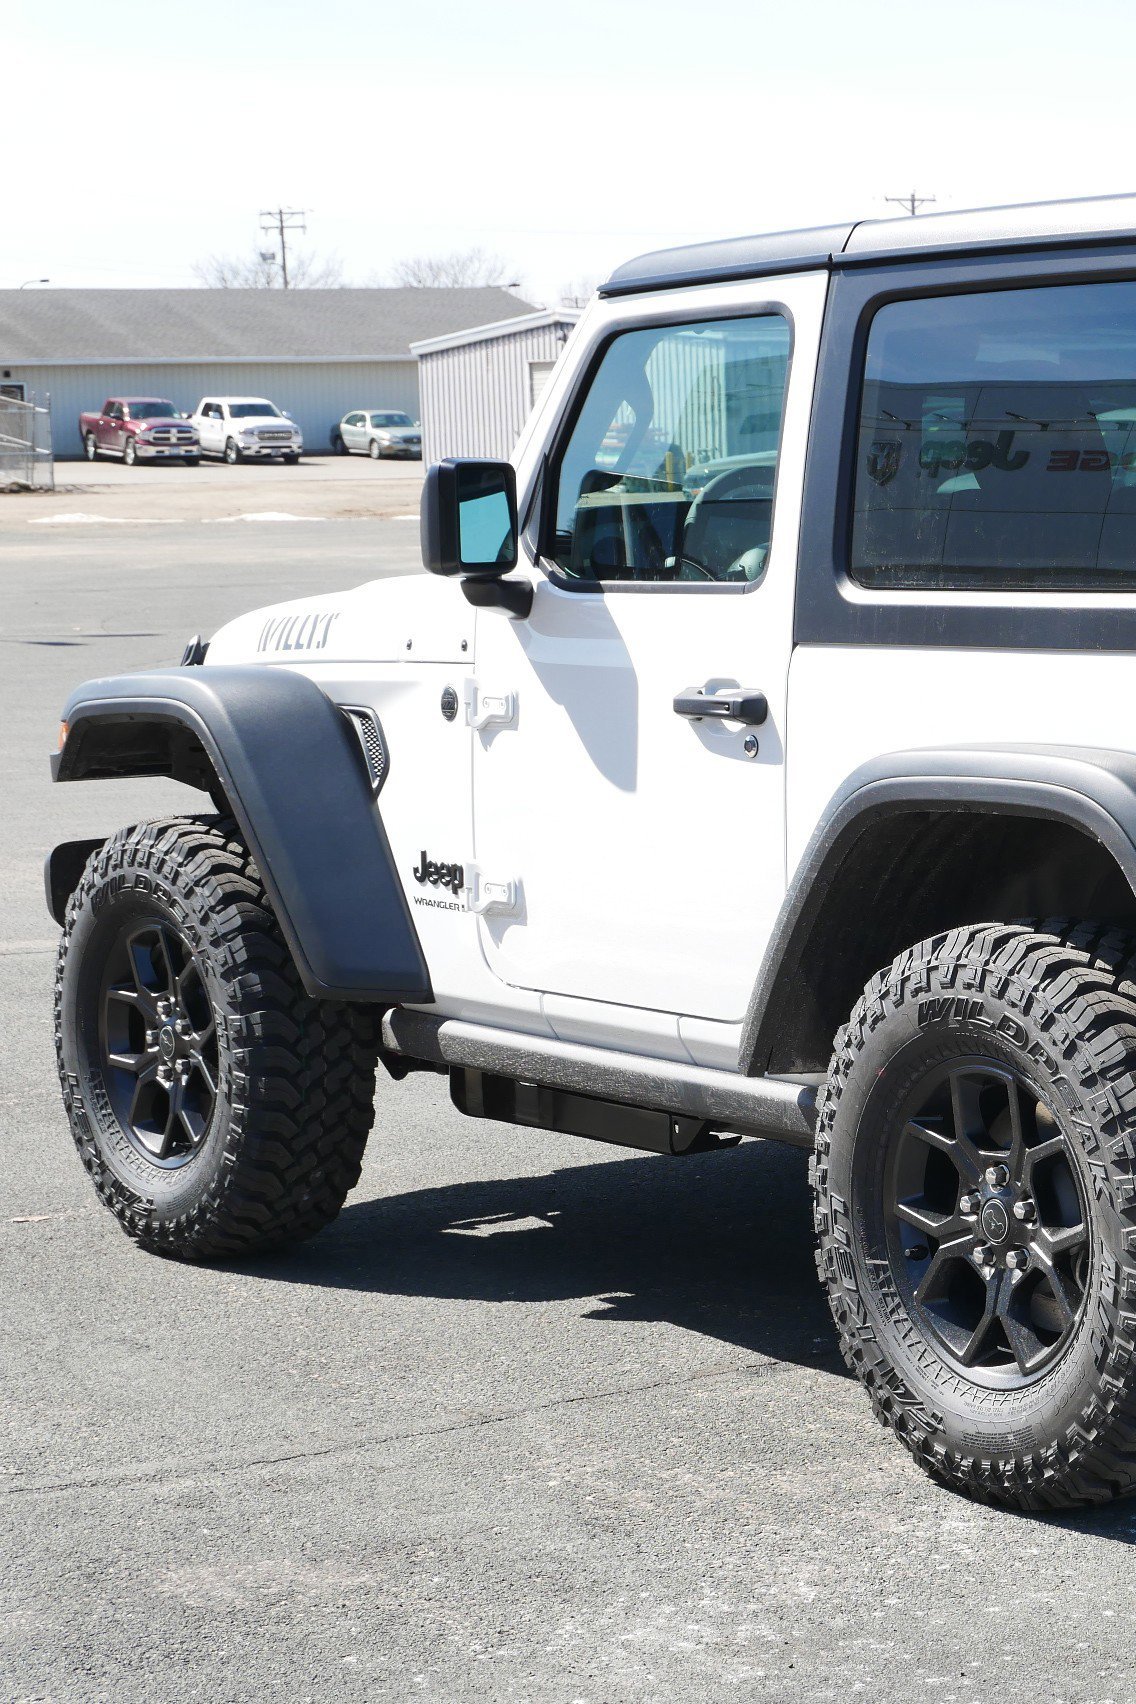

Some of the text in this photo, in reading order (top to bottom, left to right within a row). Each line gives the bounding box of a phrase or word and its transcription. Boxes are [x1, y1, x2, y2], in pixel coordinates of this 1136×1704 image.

[413, 850, 464, 895] Jeep
[413, 896, 461, 911] WRANGLER
[917, 996, 1114, 1207] WILDPEAK
